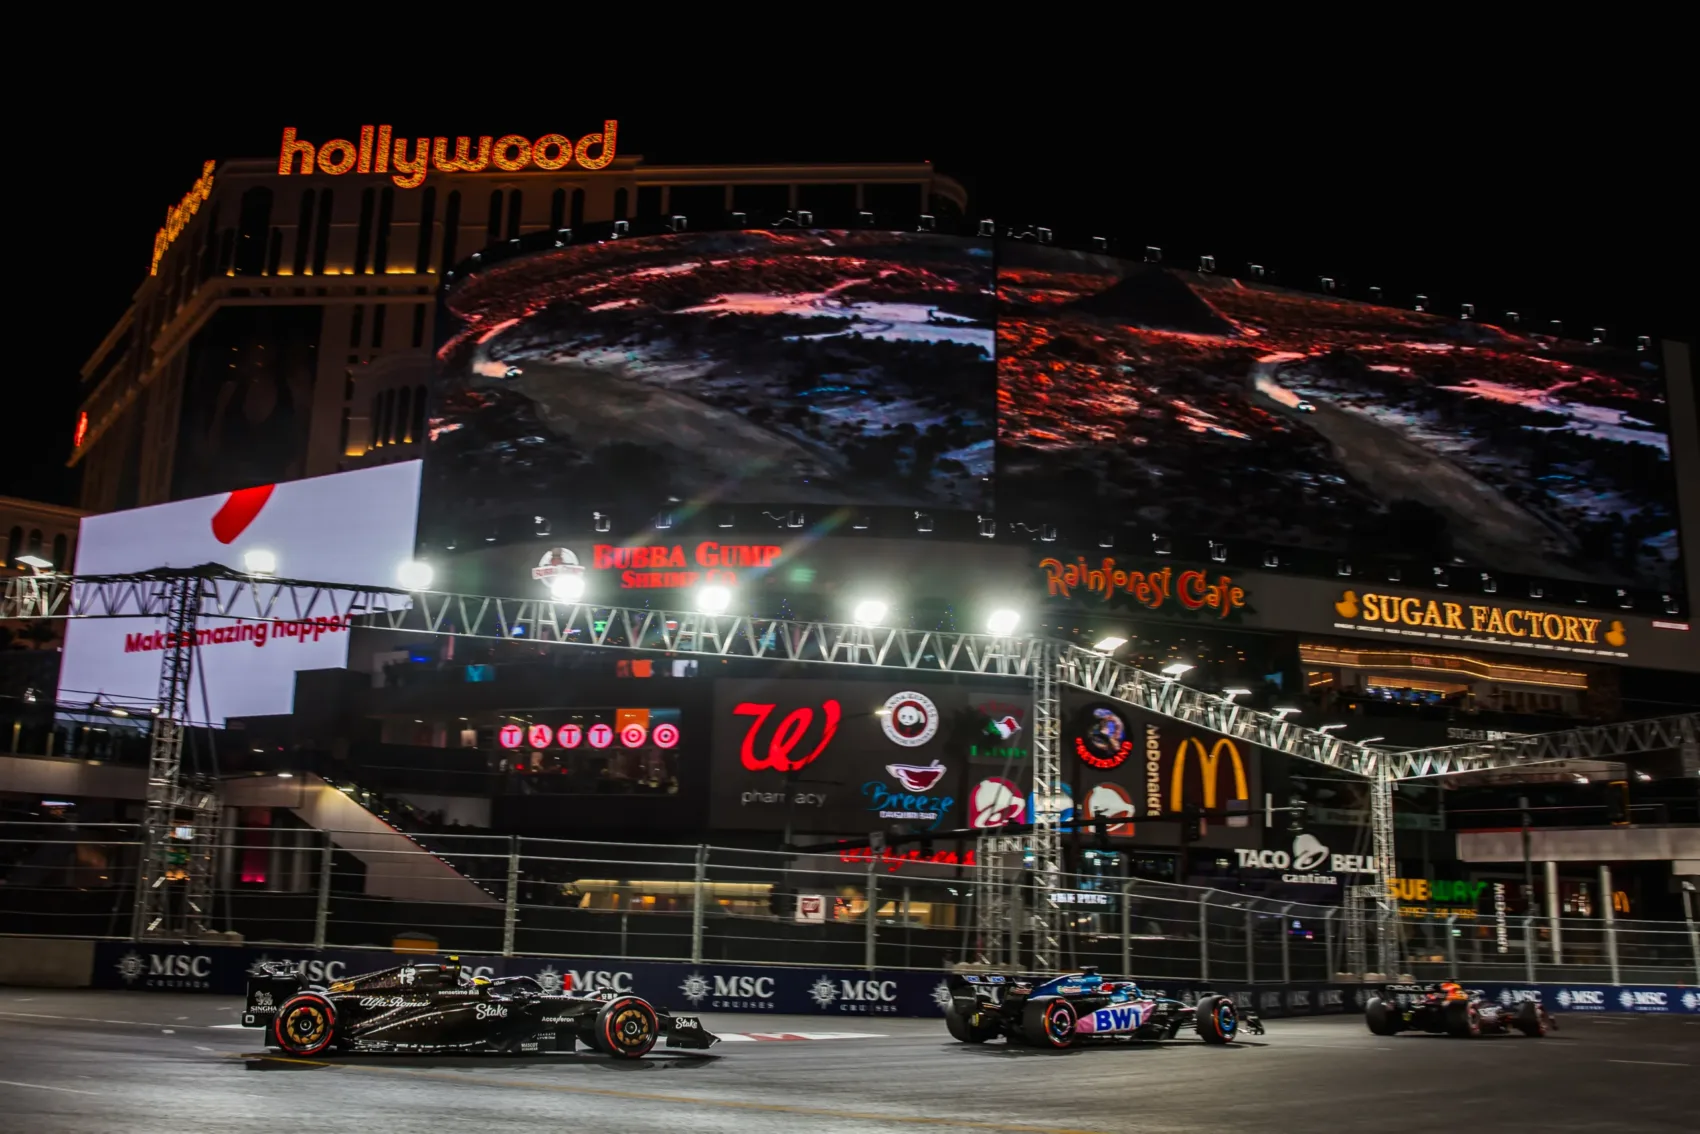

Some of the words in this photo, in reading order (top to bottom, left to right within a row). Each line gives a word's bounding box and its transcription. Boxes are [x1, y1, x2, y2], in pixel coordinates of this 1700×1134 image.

[278, 120, 617, 189] hollywood
[592, 544, 687, 569] BUBBA
[695, 541, 782, 568] GUMP
[1362, 593, 1466, 630] SUGAR
[1469, 605, 1602, 644] FACTORY
[500, 724, 680, 749] TATTOO
[861, 780, 955, 831] Breeze
[1234, 848, 1291, 869] TACO
[1331, 853, 1379, 873] BELL
[1282, 873, 1338, 885] cantina
[1387, 878, 1488, 902] SUBWAY
[148, 953, 212, 978] MSC
[459, 965, 495, 986] SC
[567, 969, 634, 994] MSC
[713, 975, 775, 998] MSC
[840, 979, 898, 1001] MSC
[359, 997, 389, 1010] Alfa
[389, 997, 430, 1008] Romeo
[712, 1000, 775, 1009] CRUISES
[840, 1003, 898, 1012] CRUSES
[1571, 990, 1605, 1004] MSC
[1633, 991, 1668, 1005] MSC
[475, 1003, 508, 1020] Stake
[675, 1017, 698, 1029] Stake
[1095, 1006, 1142, 1031] BWT
